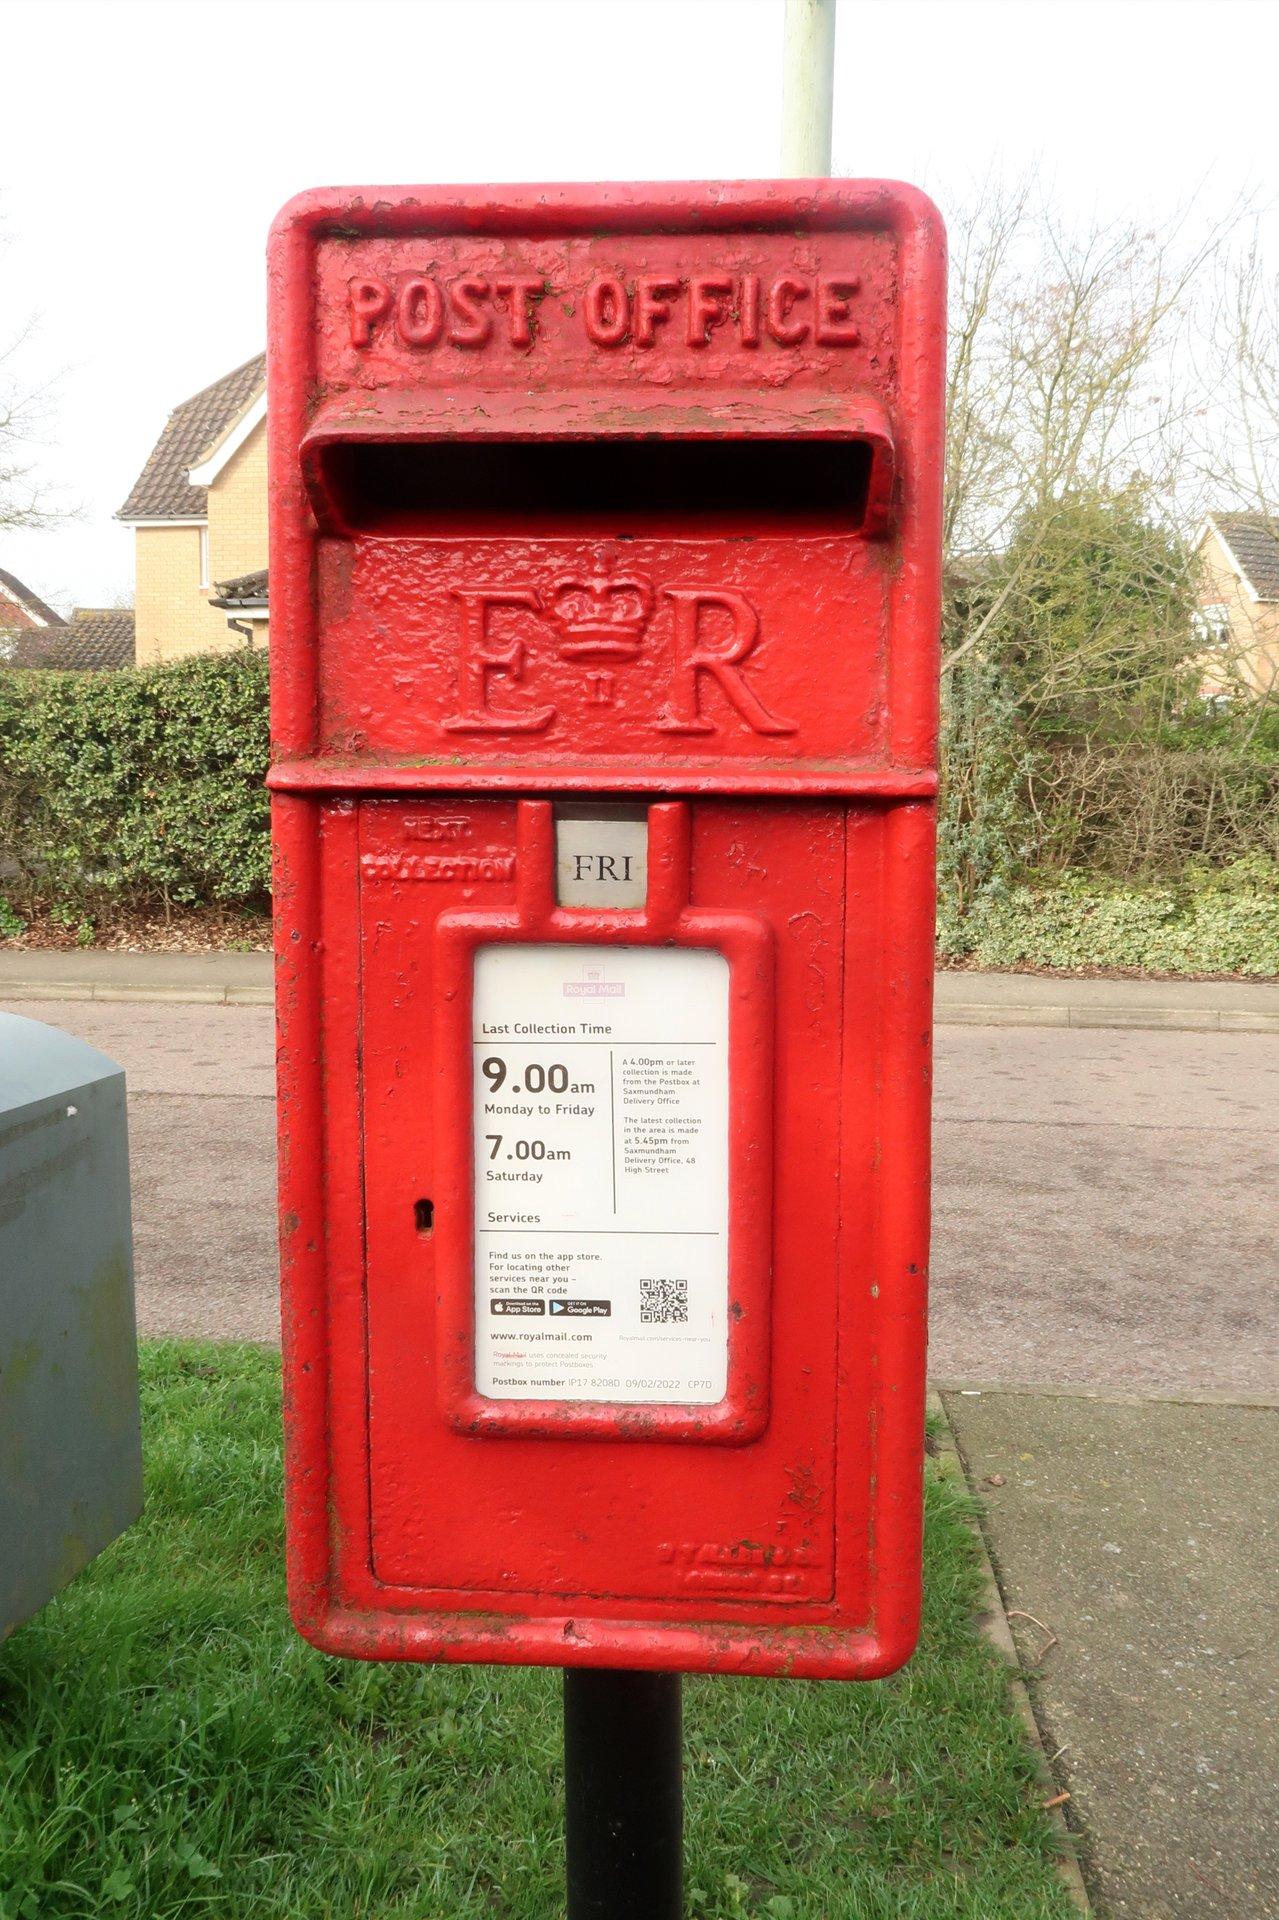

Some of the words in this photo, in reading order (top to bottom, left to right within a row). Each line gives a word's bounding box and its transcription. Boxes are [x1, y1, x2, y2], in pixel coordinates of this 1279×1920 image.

[350, 277, 545, 349] POST
[585, 275, 863, 349] OFFICE
[440, 584, 558, 733] E
[653, 584, 800, 735] R
[573, 855, 633, 881] FRI
[567, 984, 597, 995] Royal
[598, 984, 622, 994] Mail
[483, 1024, 509, 1034] Last
[514, 1024, 575, 1035] Collection
[580, 1024, 612, 1035] Time
[630, 1058, 663, 1067] 4.00pm
[482, 1057, 595, 1093] 9.00am
[485, 1104, 533, 1117] Monday
[538, 1104, 550, 1114] to
[556, 1104, 595, 1117] Friday
[635, 1137, 668, 1145] 5.45pm
[486, 1135, 571, 1160] 7.00am
[486, 1171, 543, 1183] Saturday
[488, 1212, 540, 1222] Services
[489, 1263, 503, 1271] For
[507, 1263, 542, 1272] locating
[552, 1276, 568, 1284] you
[567, 1306, 592, 1314] Google
[593, 1307, 607, 1315] Play
[491, 1332, 592, 1342] www.royalmail.com
[492, 1377, 527, 1385] Postbox
[626, 1379, 680, 1389] 09/02/2022
